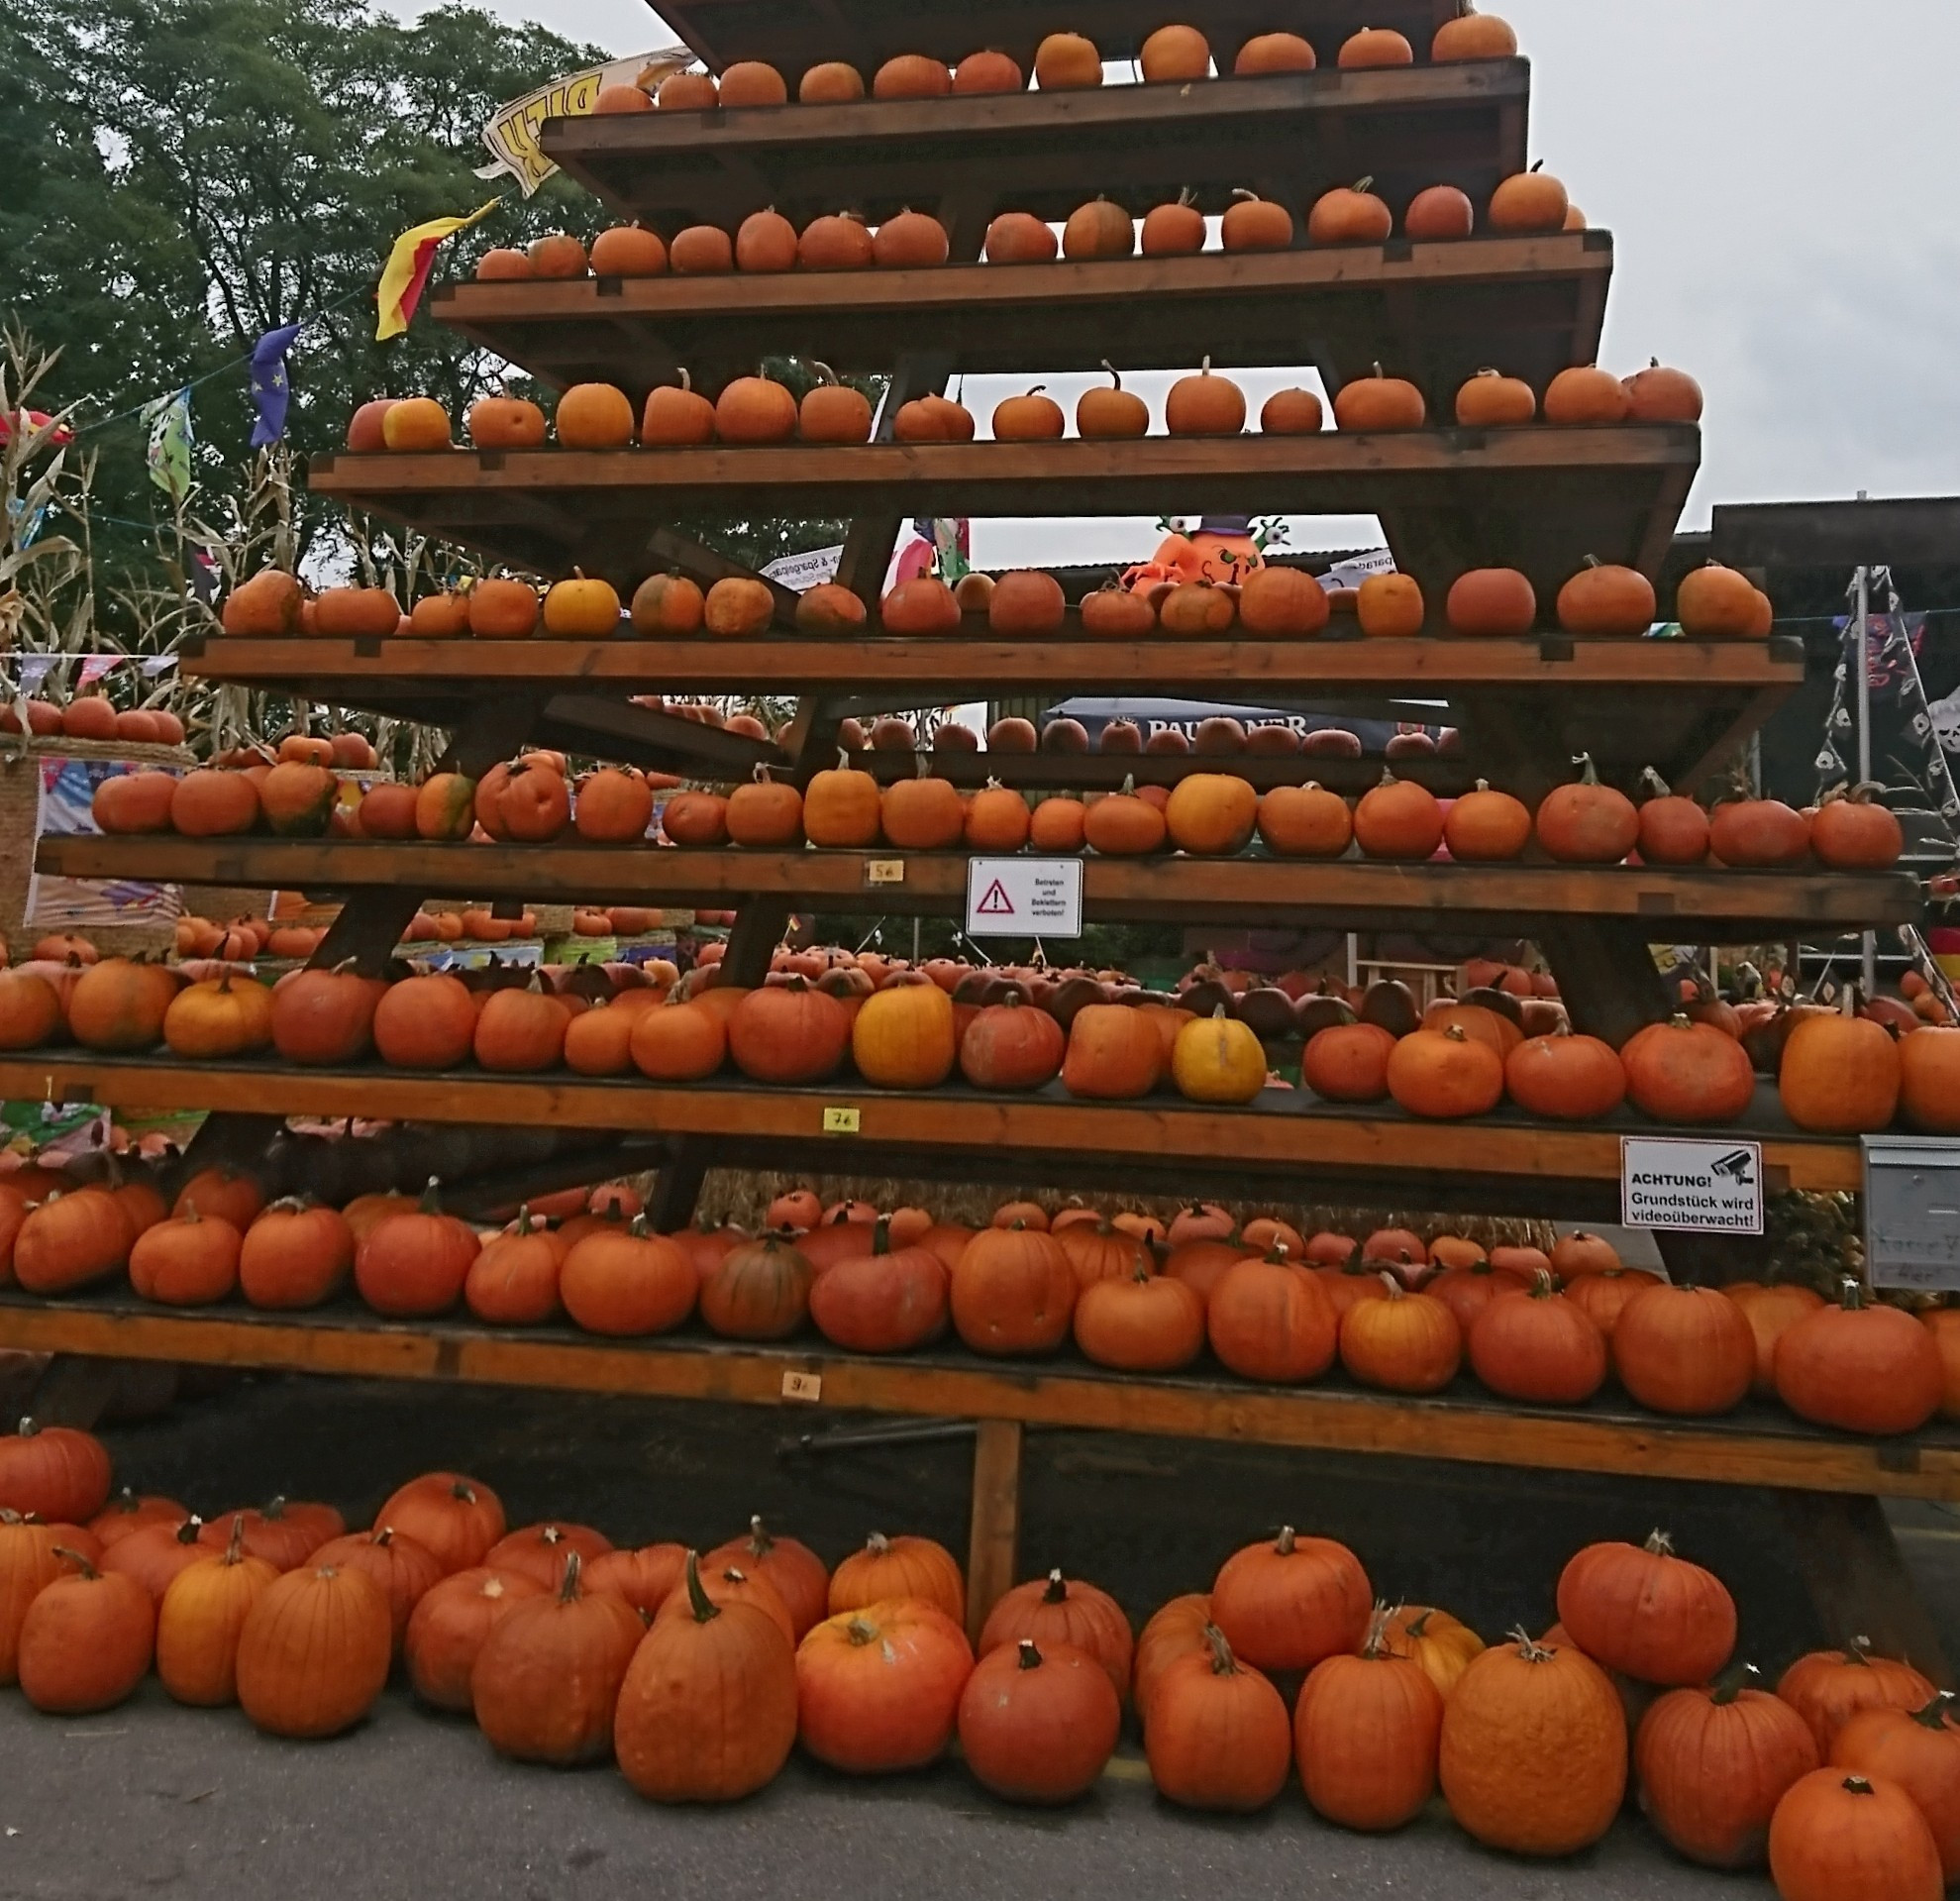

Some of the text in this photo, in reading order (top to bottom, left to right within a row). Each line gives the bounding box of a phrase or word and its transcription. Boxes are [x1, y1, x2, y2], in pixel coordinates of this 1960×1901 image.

[1631, 1173, 1711, 1188] ACHTUNG!
[1631, 1192, 1754, 1210] Grundstück wird
[1632, 1210, 1754, 1226] videoüberwacht!
